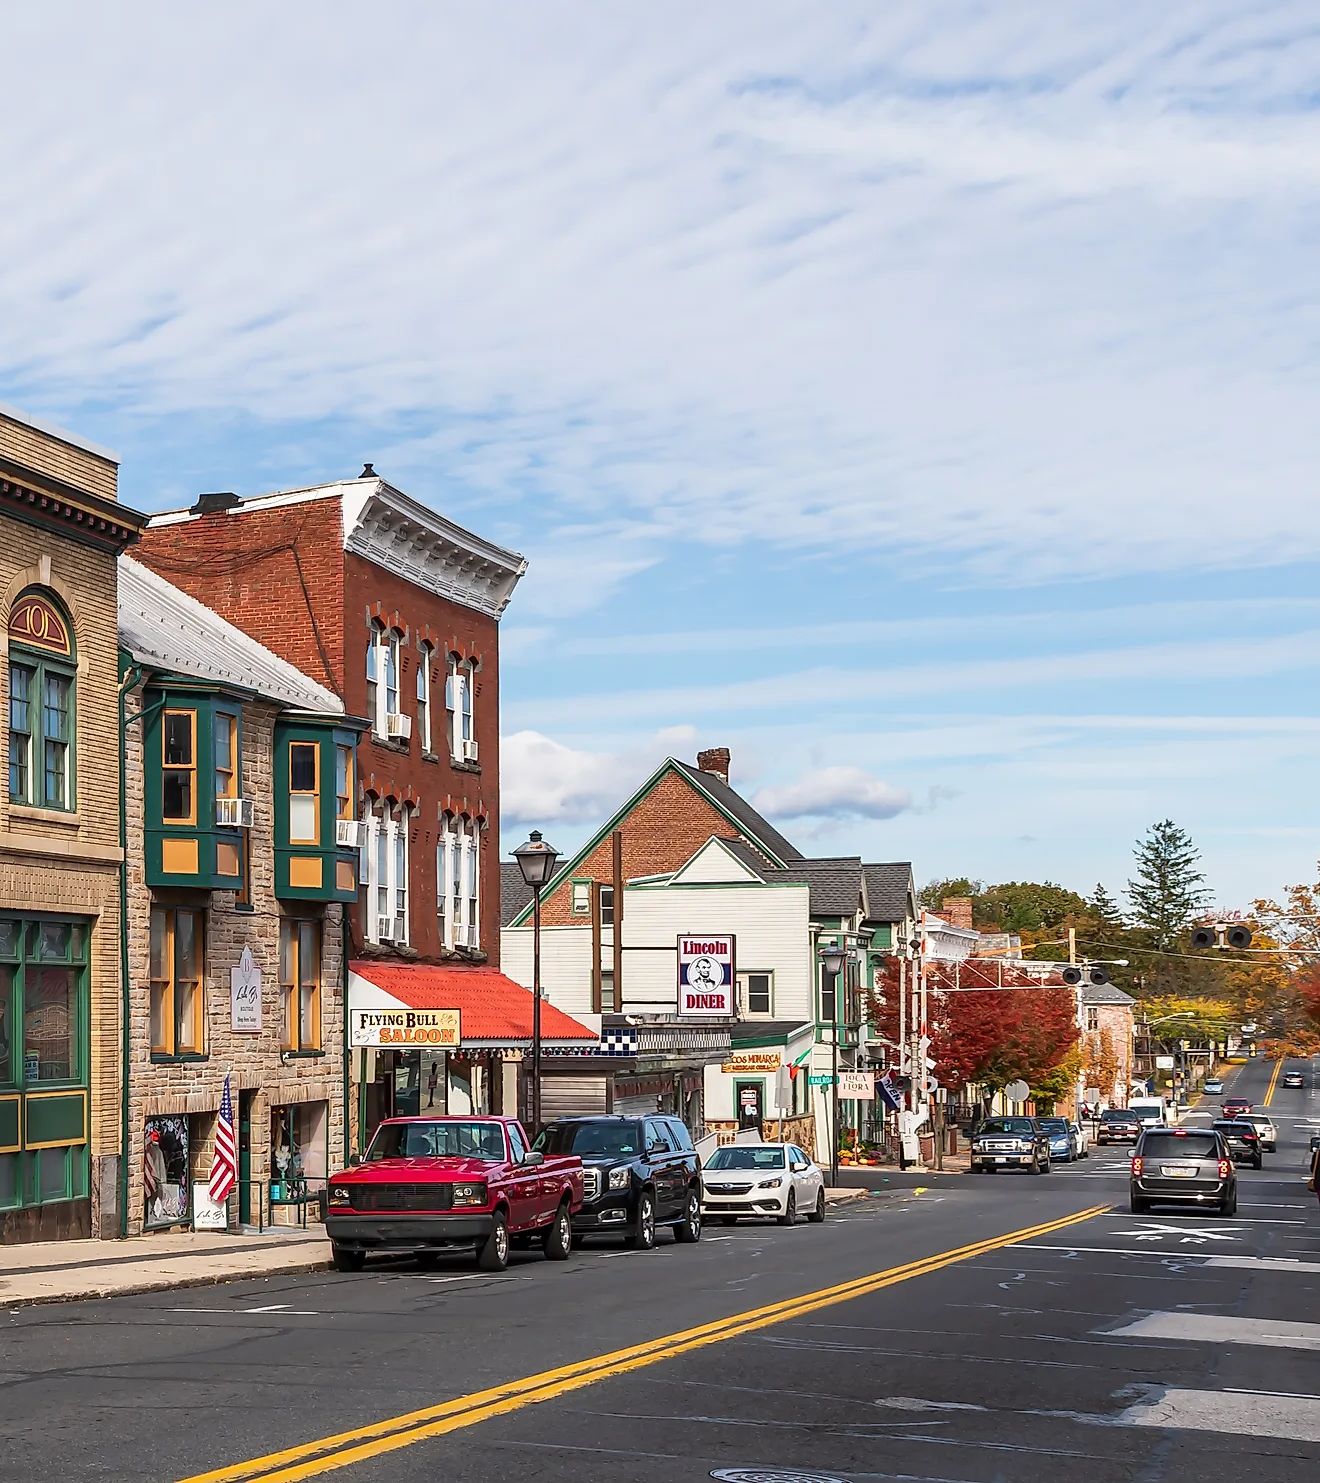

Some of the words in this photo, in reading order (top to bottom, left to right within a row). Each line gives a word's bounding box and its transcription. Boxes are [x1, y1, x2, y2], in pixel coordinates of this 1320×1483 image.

[683, 941, 728, 954] Lincoln
[686, 994, 725, 1009] DINER
[360, 1013, 403, 1029] FLYING
[406, 1012, 438, 1028] BULL
[379, 1028, 455, 1043] SALOON
[731, 1055, 747, 1064] COS
[811, 1076, 832, 1084] RAILROA
[845, 1074, 867, 1083] LOCA
[843, 1083, 869, 1091] FLORA
[884, 1078, 901, 1101] OPEN
